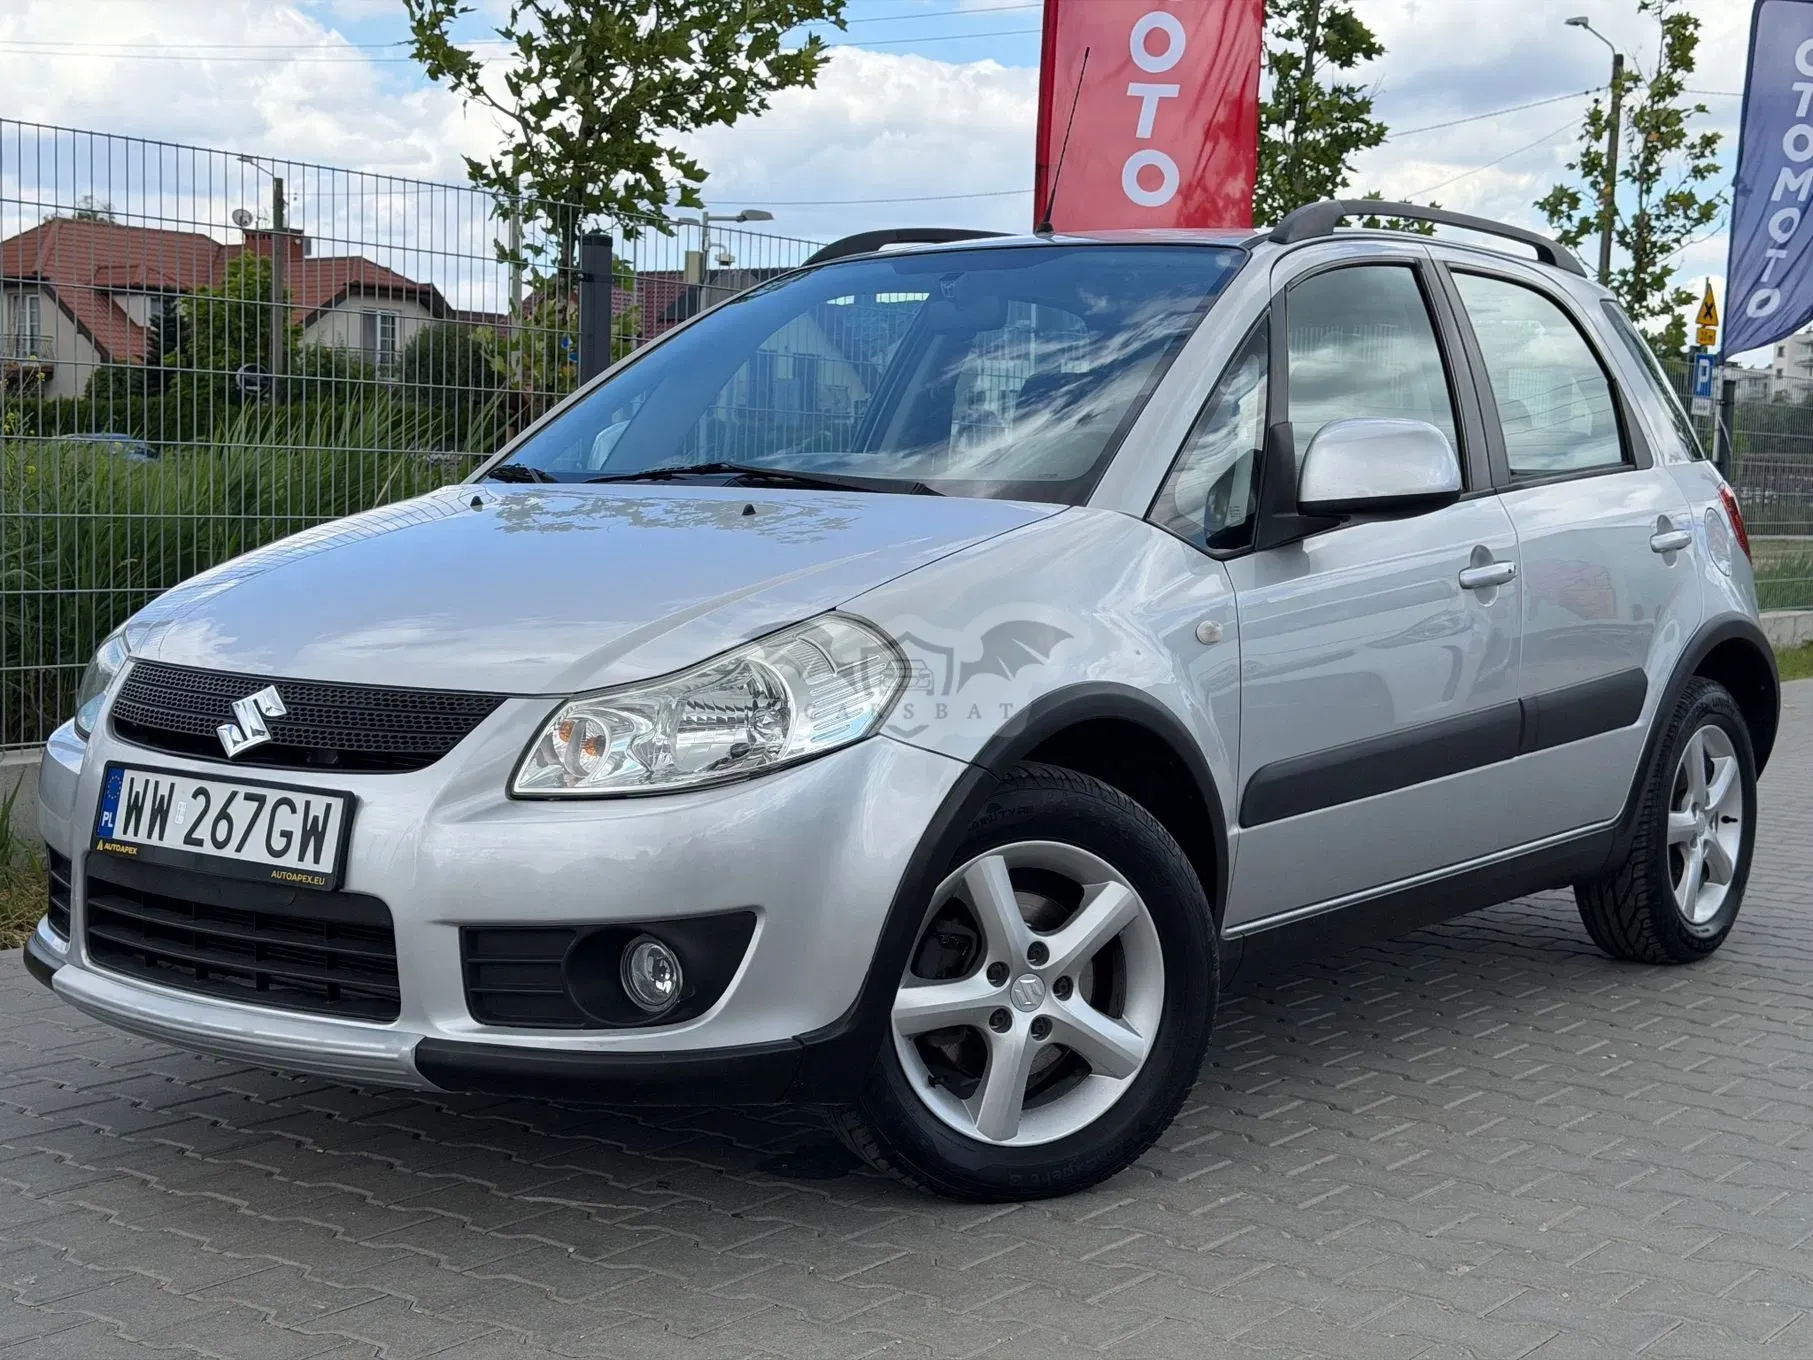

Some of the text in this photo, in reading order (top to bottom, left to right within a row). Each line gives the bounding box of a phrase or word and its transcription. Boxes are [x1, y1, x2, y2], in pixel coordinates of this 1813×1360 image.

[1121, 10, 1187, 208] OTO
[1697, 358, 1711, 393] P
[101, 811, 114, 828] PL
[121, 776, 333, 865] WW 267GW
[103, 842, 138, 855] AUTOAPEX
[270, 870, 326, 886] AUTOAPEX.EU
